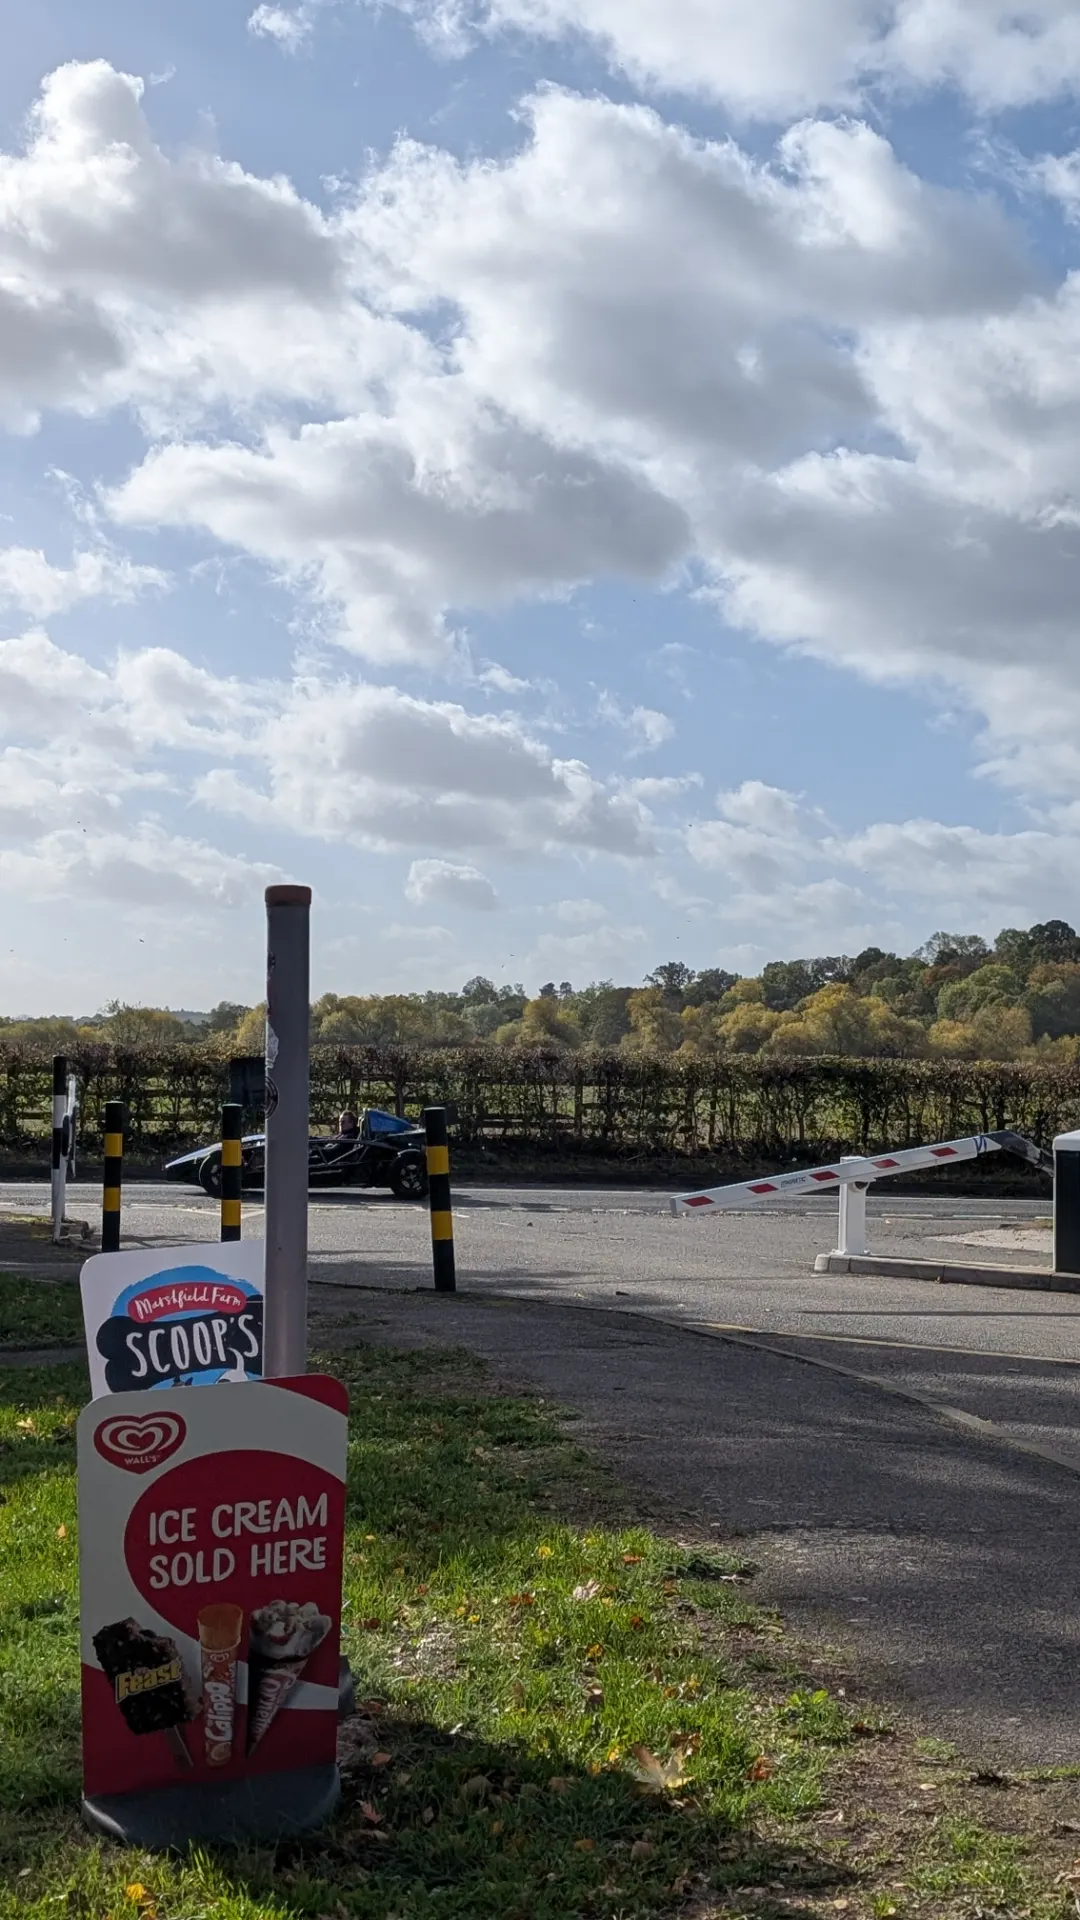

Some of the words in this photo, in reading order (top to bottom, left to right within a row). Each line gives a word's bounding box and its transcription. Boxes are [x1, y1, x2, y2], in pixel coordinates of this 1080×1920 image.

[135, 1286, 210, 1320] Marshfield
[211, 1287, 242, 1307] Farm
[126, 1314, 260, 1378] SCOOP'S
[124, 1455, 157, 1466] WALL'S
[149, 1507, 197, 1546] ICE
[211, 1492, 328, 1539] CREAM
[149, 1547, 236, 1590] SOLD
[250, 1536, 328, 1578] HERE
[116, 1657, 182, 1703] Feast
[204, 1681, 235, 1741] Calippo
